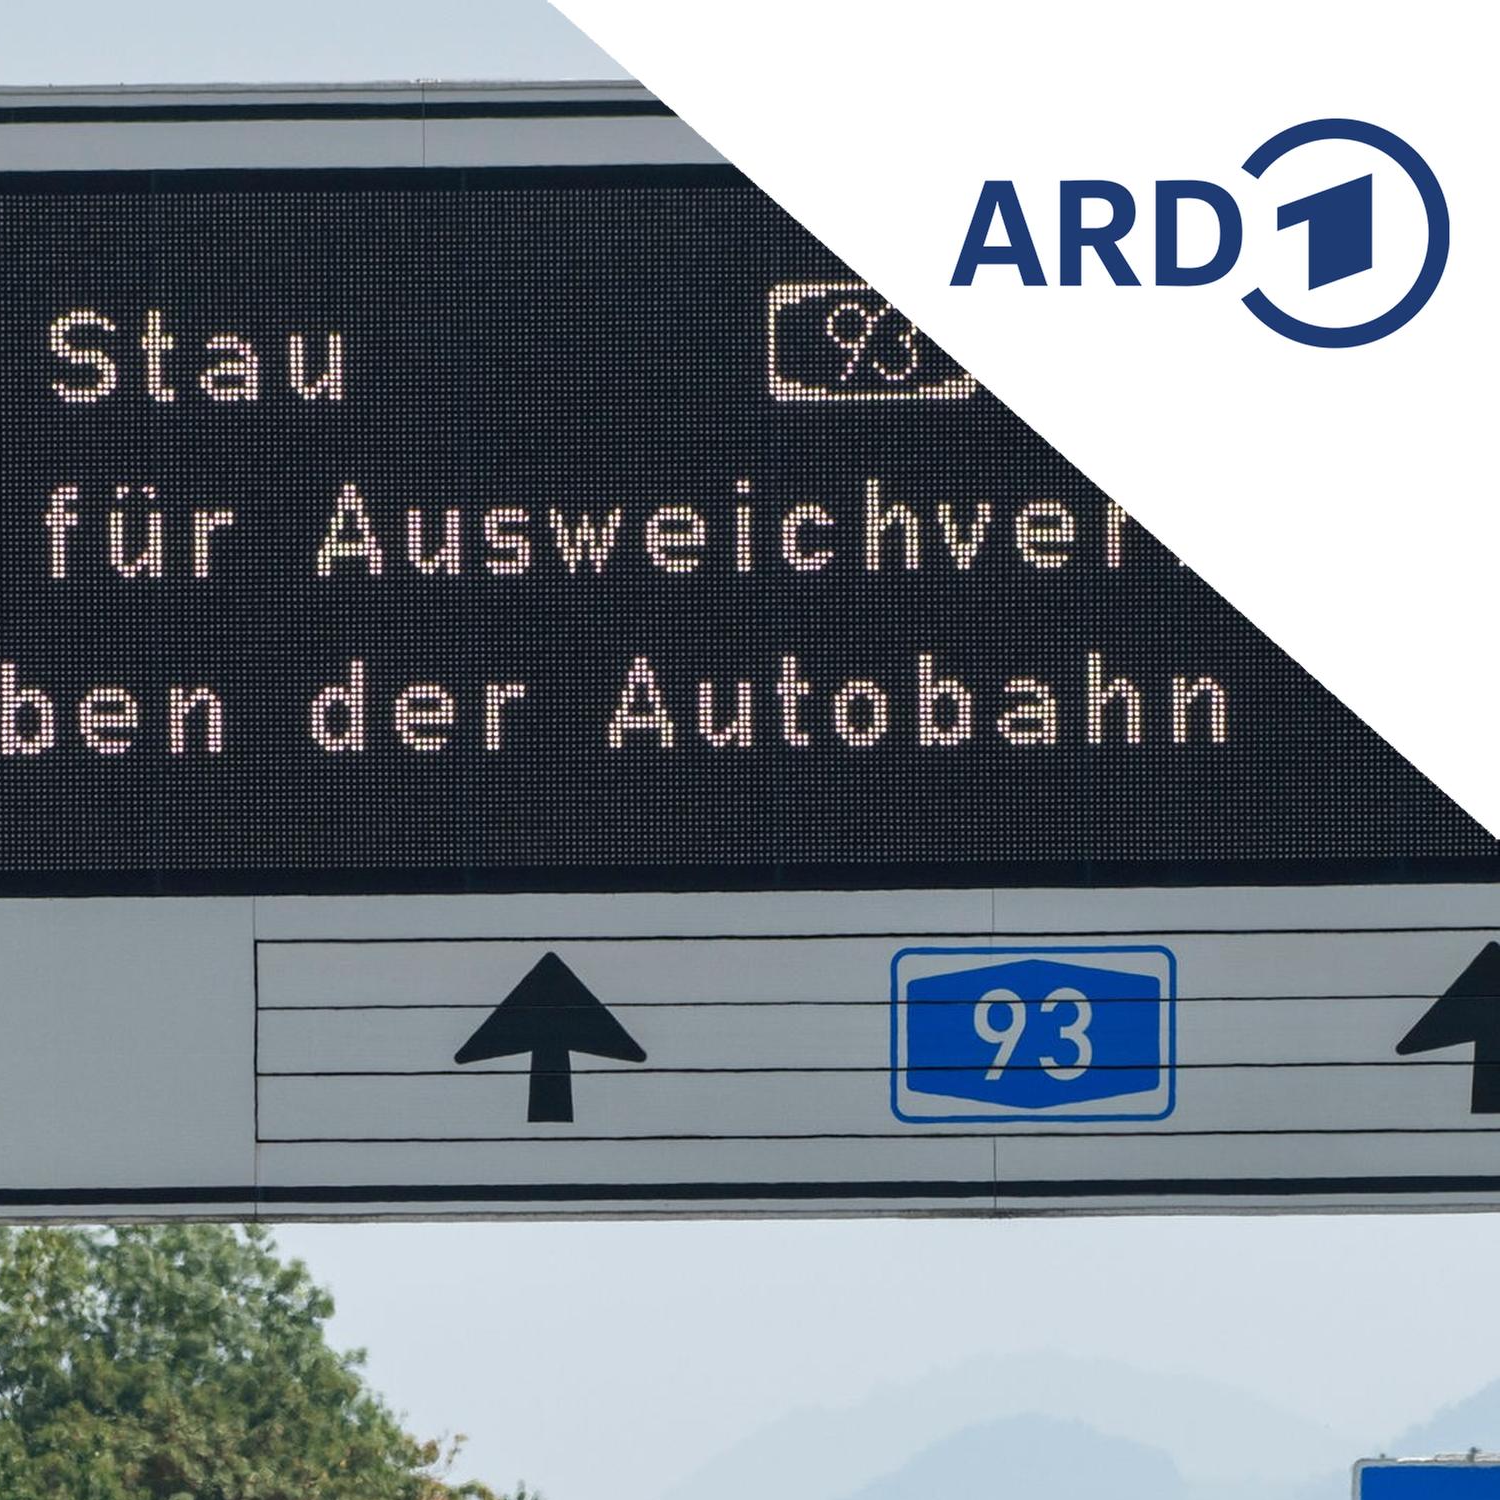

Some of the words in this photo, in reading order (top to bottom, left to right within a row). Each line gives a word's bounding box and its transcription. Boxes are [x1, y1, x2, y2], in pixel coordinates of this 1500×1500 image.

[50, 310, 343, 403] Stau
[45, 486, 234, 579] für
[317, 479, 1130, 577] Ausweichver
[311, 659, 525, 752] der
[608, 652, 1227, 748] Autobahn
[973, 988, 1093, 1081] 93
